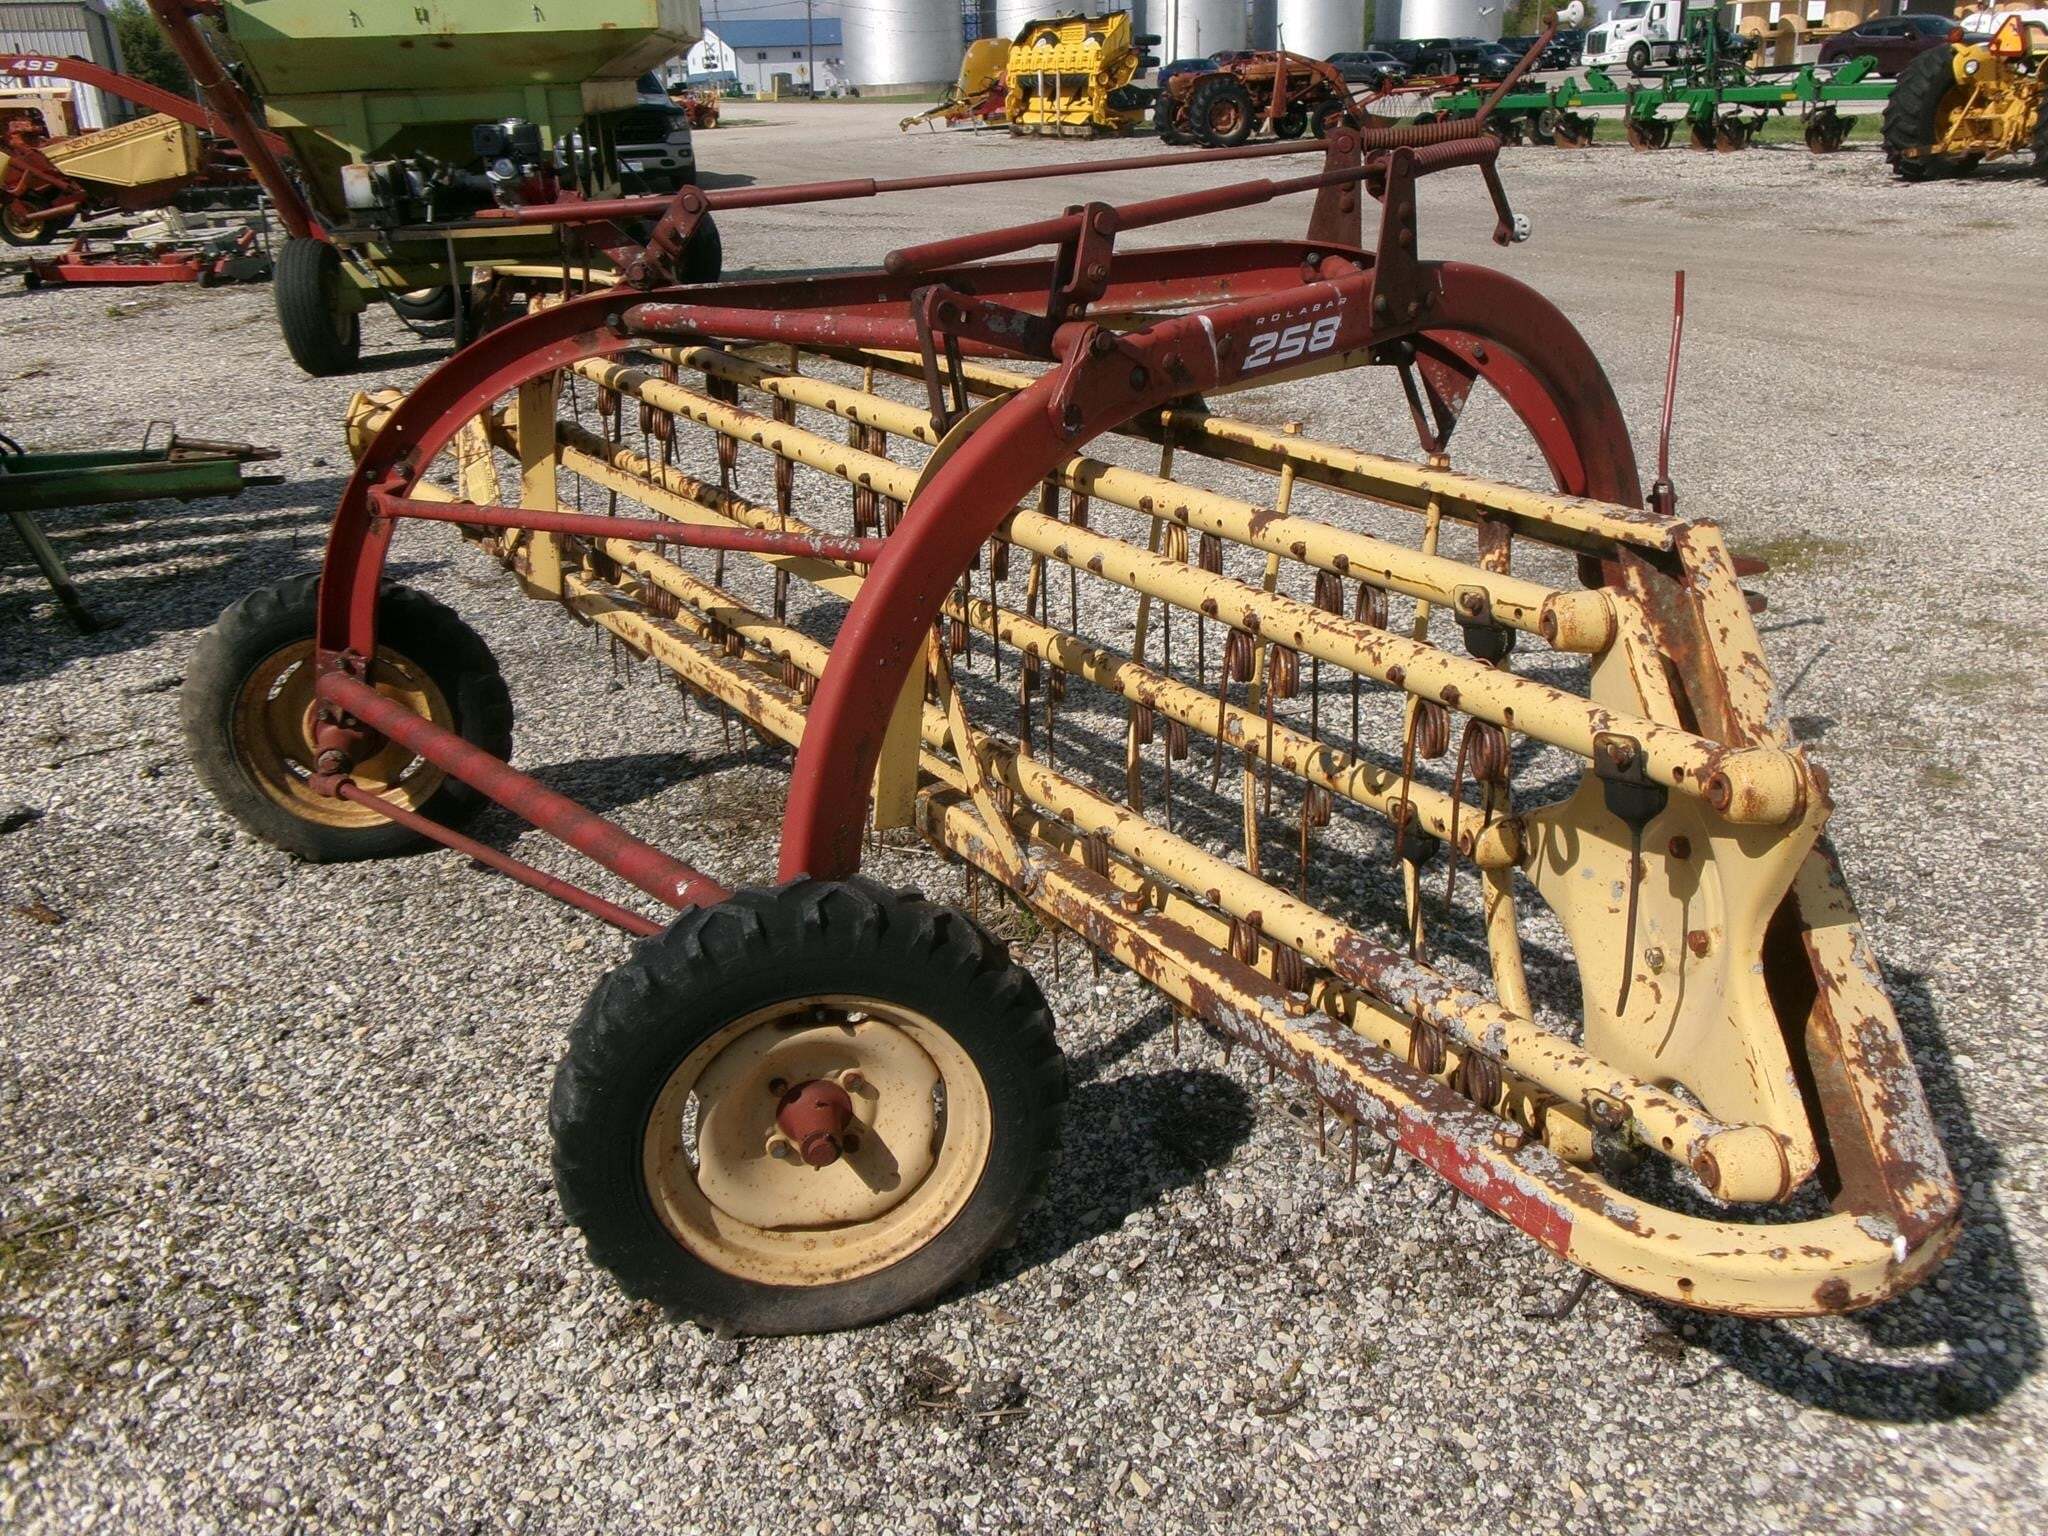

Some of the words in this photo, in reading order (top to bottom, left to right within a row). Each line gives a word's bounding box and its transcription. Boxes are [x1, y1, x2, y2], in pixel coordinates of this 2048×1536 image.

[12, 60, 59, 72] 499
[64, 136, 93, 151] NEW
[100, 117, 159, 140] HOLLAND
[1255, 297, 1348, 325] ROLABAR
[1241, 315, 1342, 370] 258
